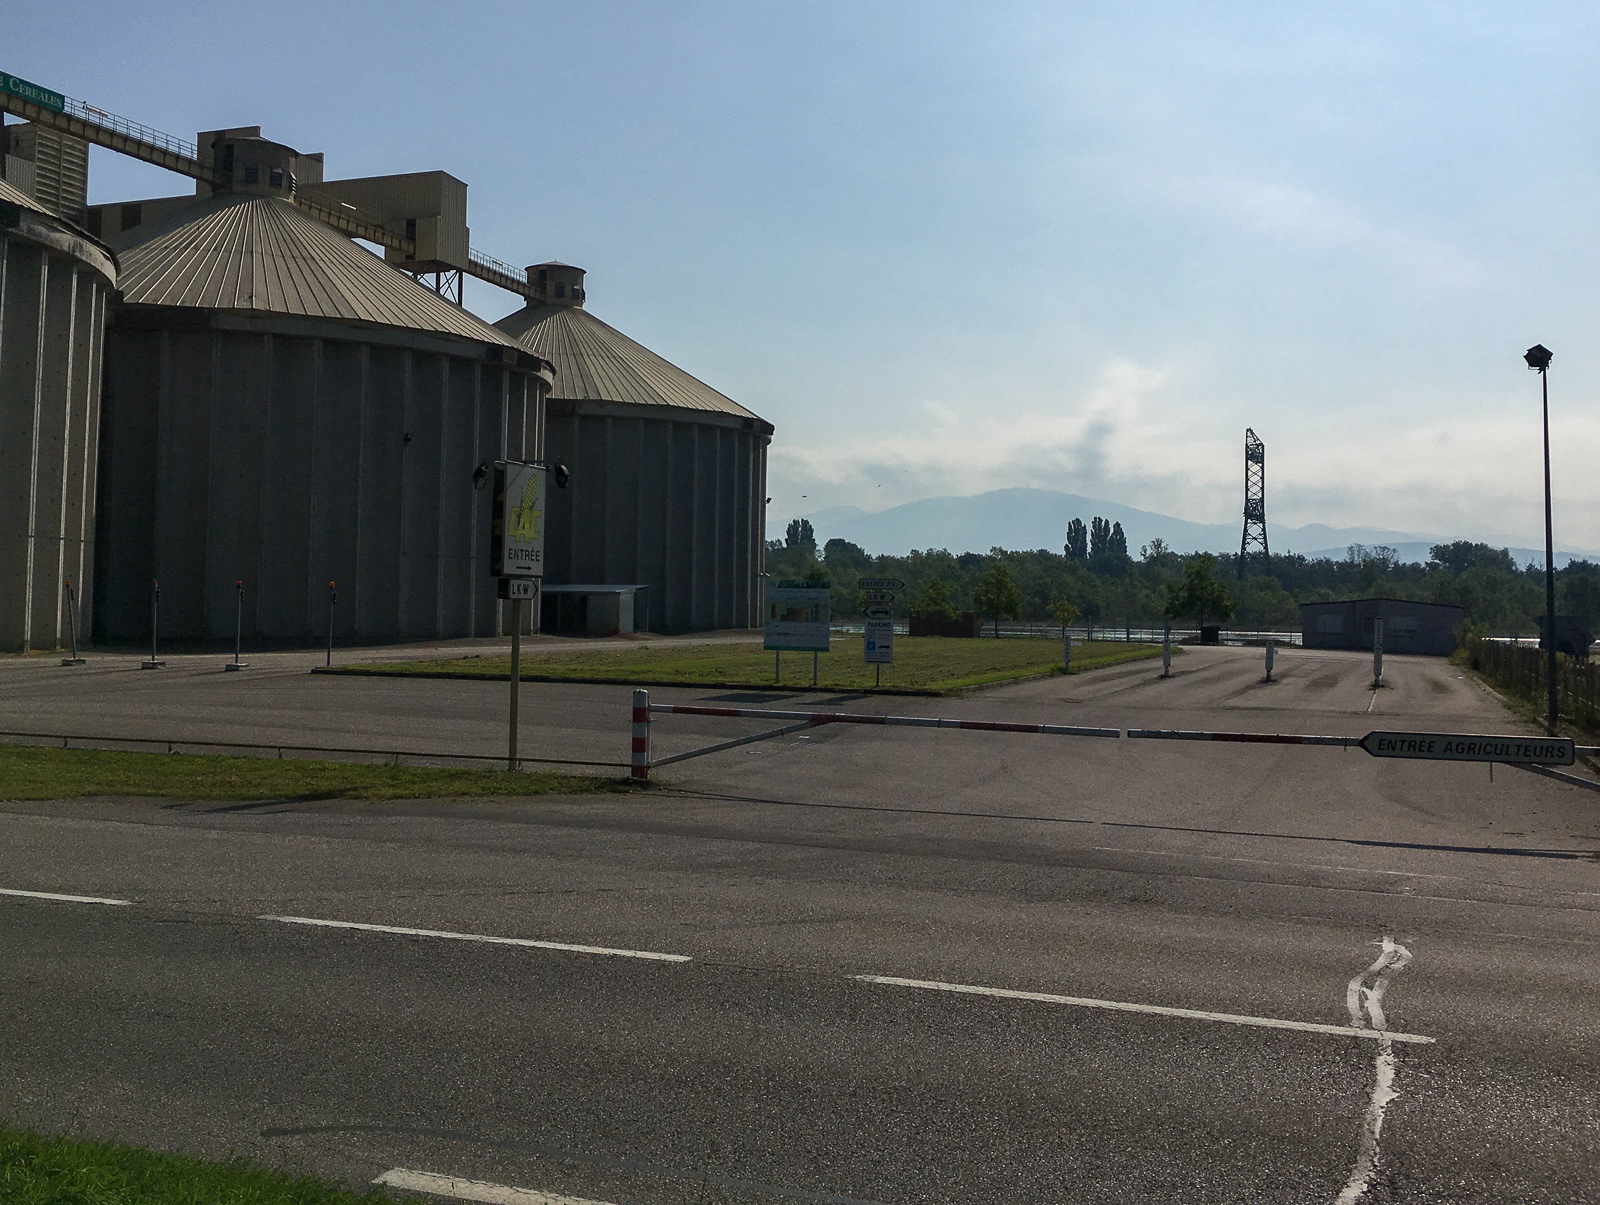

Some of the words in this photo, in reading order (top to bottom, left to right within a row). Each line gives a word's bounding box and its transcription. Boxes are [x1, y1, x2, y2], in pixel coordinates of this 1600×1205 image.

[508, 547, 540, 562] ENTRÉE
[511, 583, 530, 595] LKW
[1378, 738, 1435, 753] ENTRÉE
[1443, 741, 1566, 759] AGRICULTEURS
